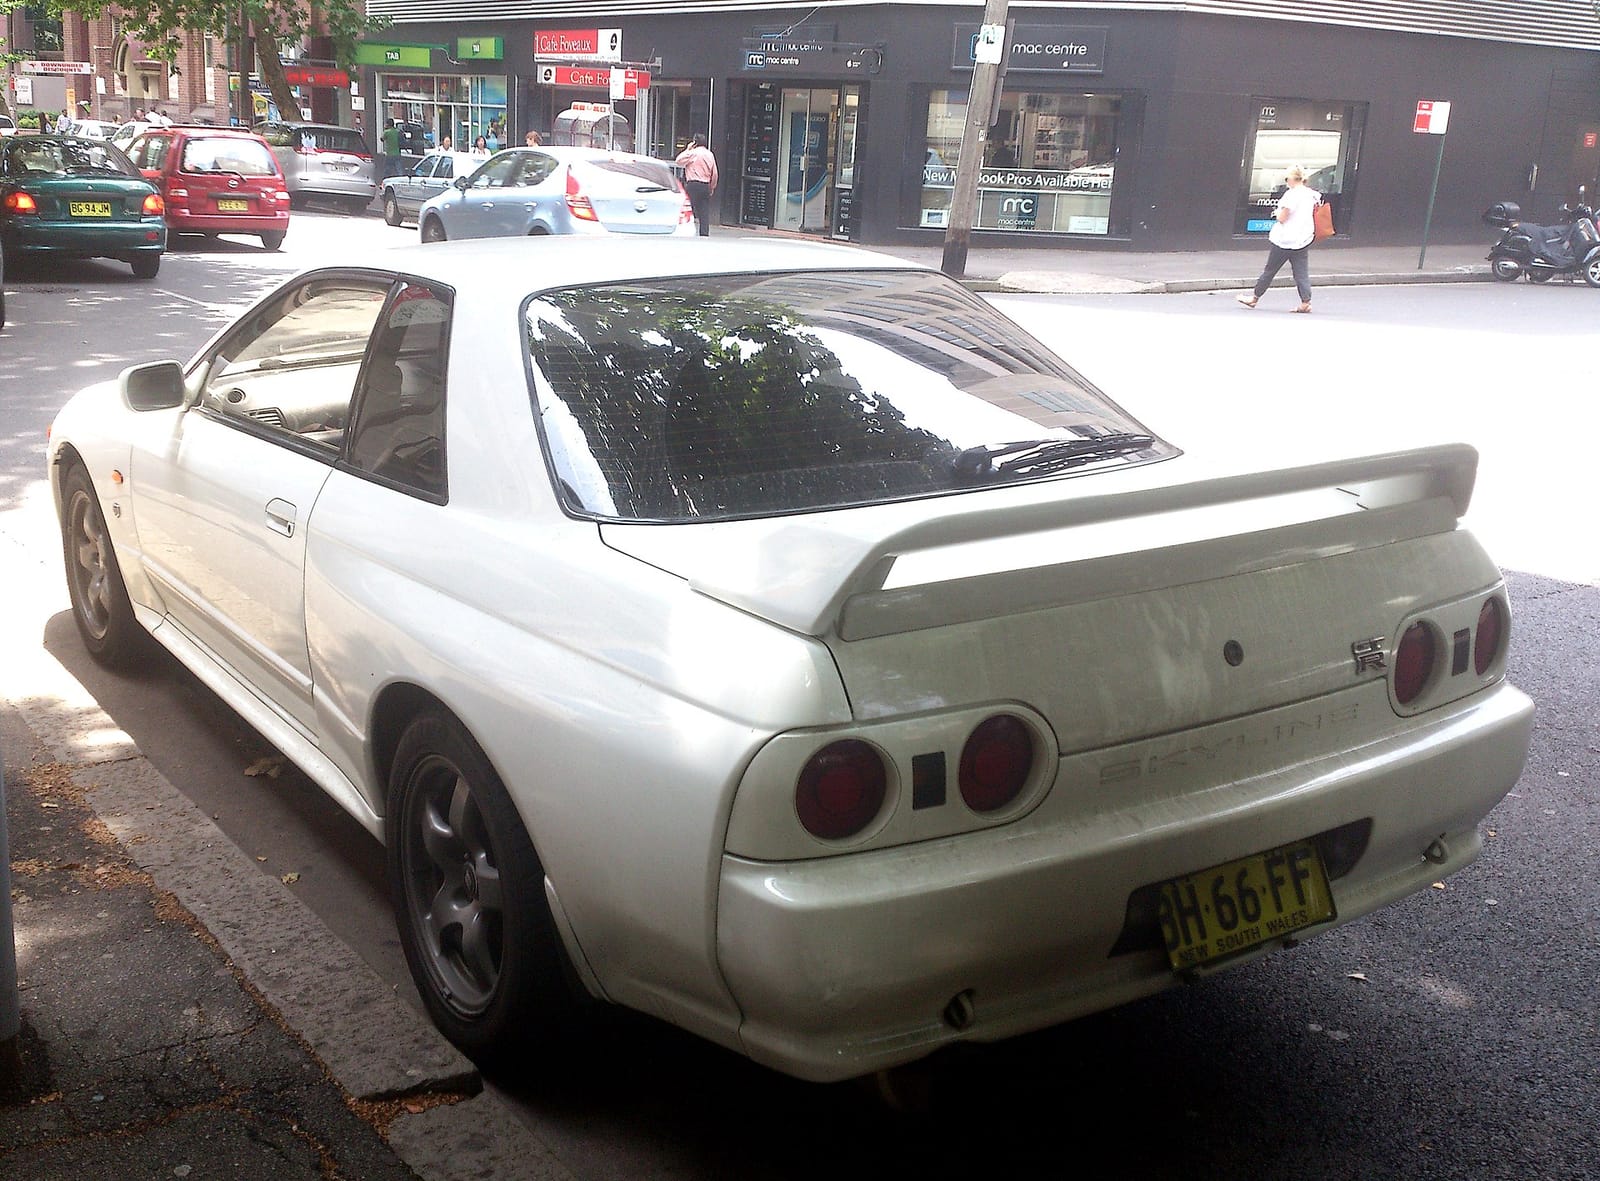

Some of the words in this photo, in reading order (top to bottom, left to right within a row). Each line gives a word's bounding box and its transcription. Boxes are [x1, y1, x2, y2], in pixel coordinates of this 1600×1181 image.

[559, 36, 592, 52] Foveaux
[1012, 42, 1043, 55] mac
[1045, 42, 1089, 56] centre
[385, 51, 400, 60] TAB
[765, 56, 780, 65] mac
[780, 57, 800, 66] centre
[922, 169, 949, 183] New
[950, 169, 1006, 185] MBook
[1006, 173, 1032, 186] Pros
[1034, 173, 1089, 189] Available
[1091, 177, 1114, 190] Her
[998, 218, 1014, 226] mac
[1099, 703, 1359, 785] SKYLINE
[1179, 943, 1209, 962] NEW
[1216, 926, 1262, 952] SOUTH
[1266, 910, 1309, 934] WALES
